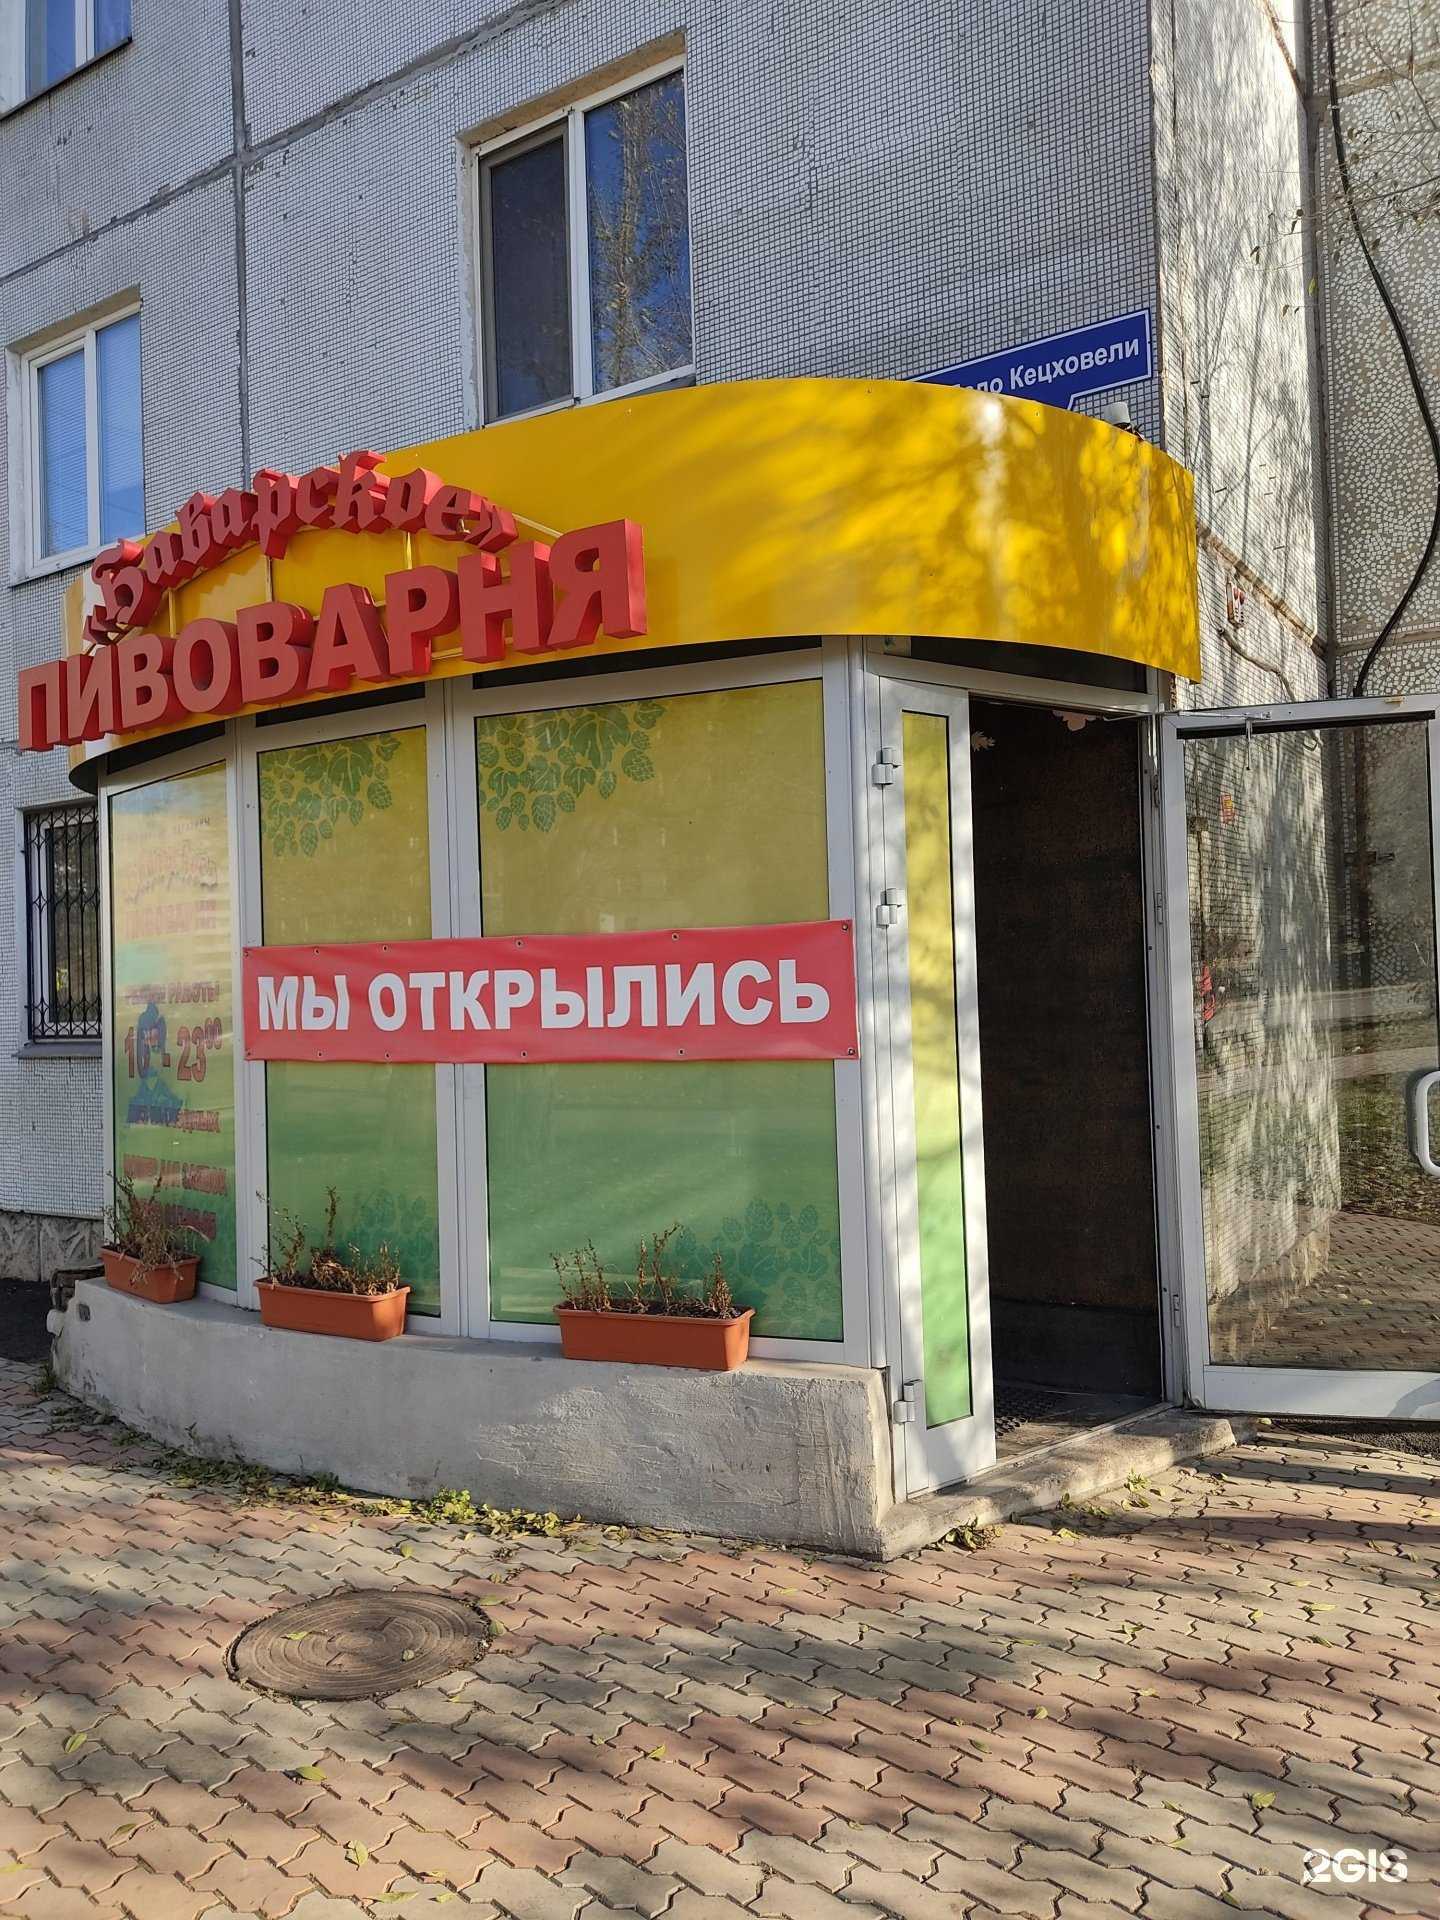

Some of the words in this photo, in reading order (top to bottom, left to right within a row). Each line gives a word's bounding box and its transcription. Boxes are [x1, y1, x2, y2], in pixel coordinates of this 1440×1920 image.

[1010, 337, 1140, 391] Кецховели
[18, 518, 647, 752] ПИВОВАРНЯ
[257, 974, 351, 1031] МЫ
[367, 958, 832, 1032] ОТКРЫЛИСЬ
